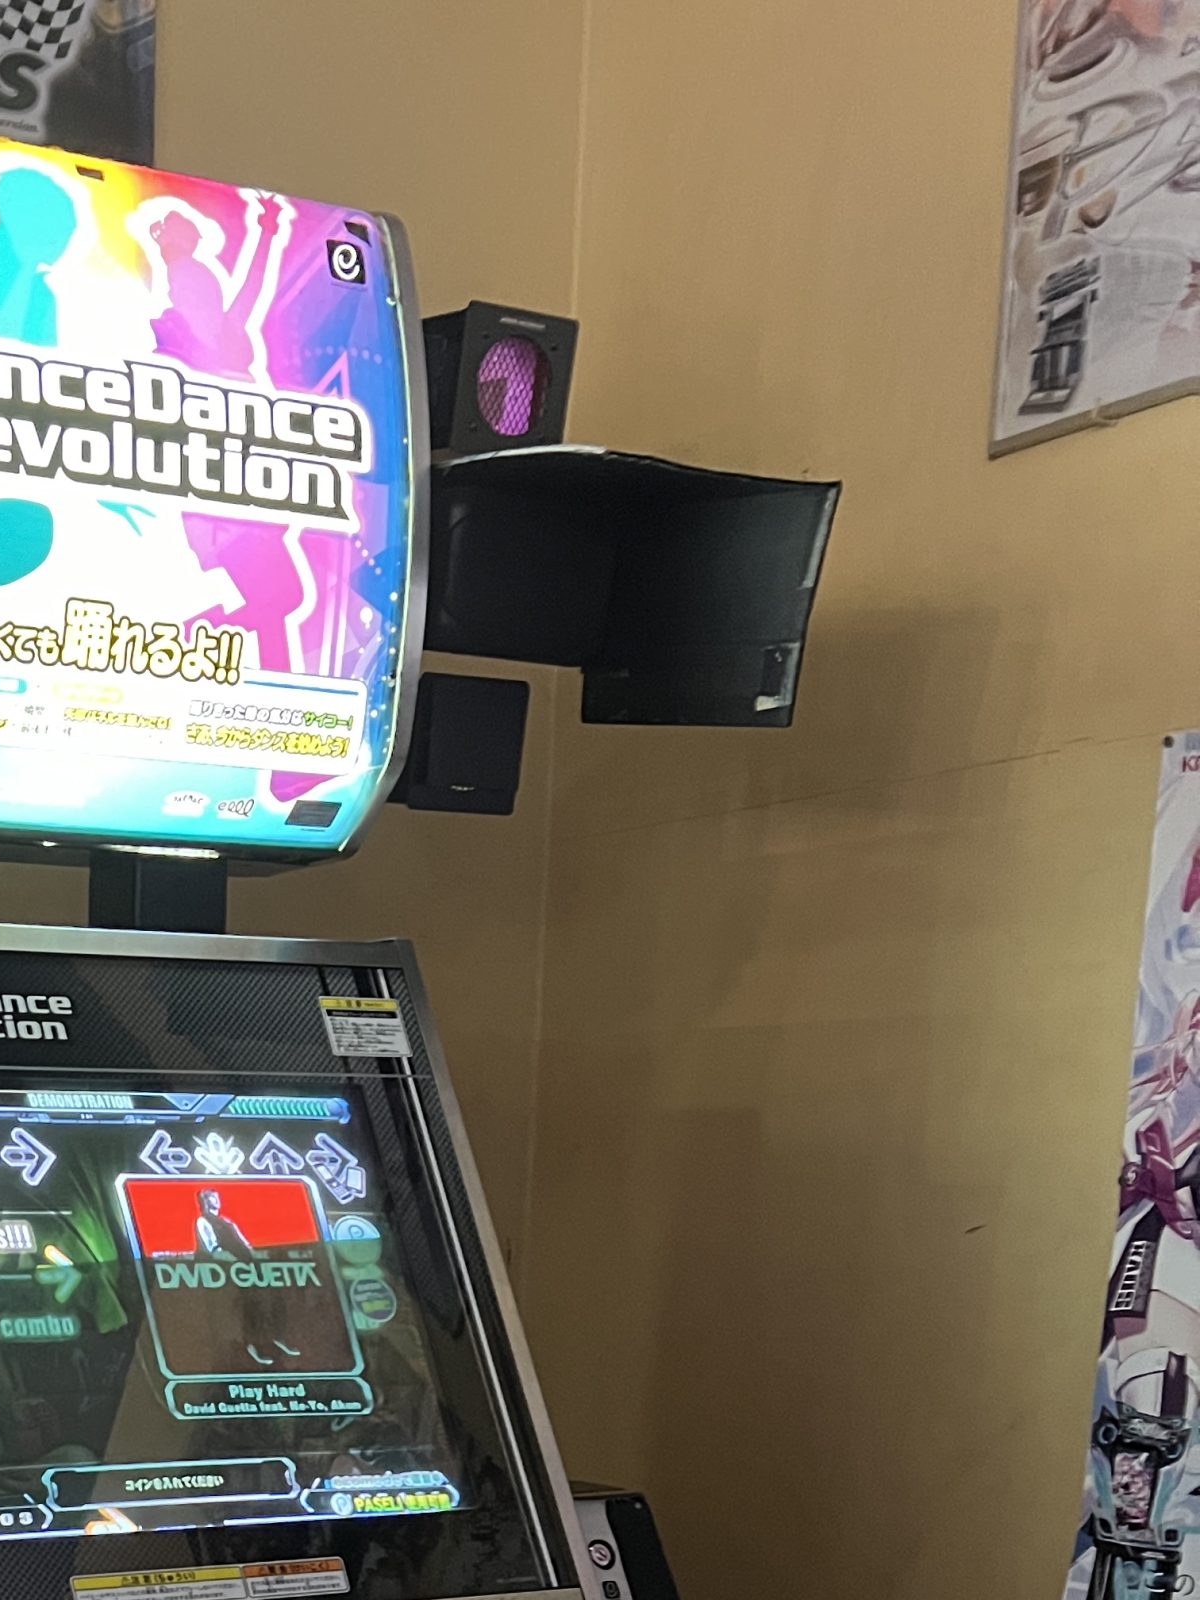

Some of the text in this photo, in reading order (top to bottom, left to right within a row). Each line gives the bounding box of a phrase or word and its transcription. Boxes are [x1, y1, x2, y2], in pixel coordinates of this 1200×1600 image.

[27, 1093, 134, 1109] DEMONSTRATION
[0, 1314, 74, 1338] combo
[229, 1384, 306, 1401] Play Hard
[184, 1403, 216, 1414] David
